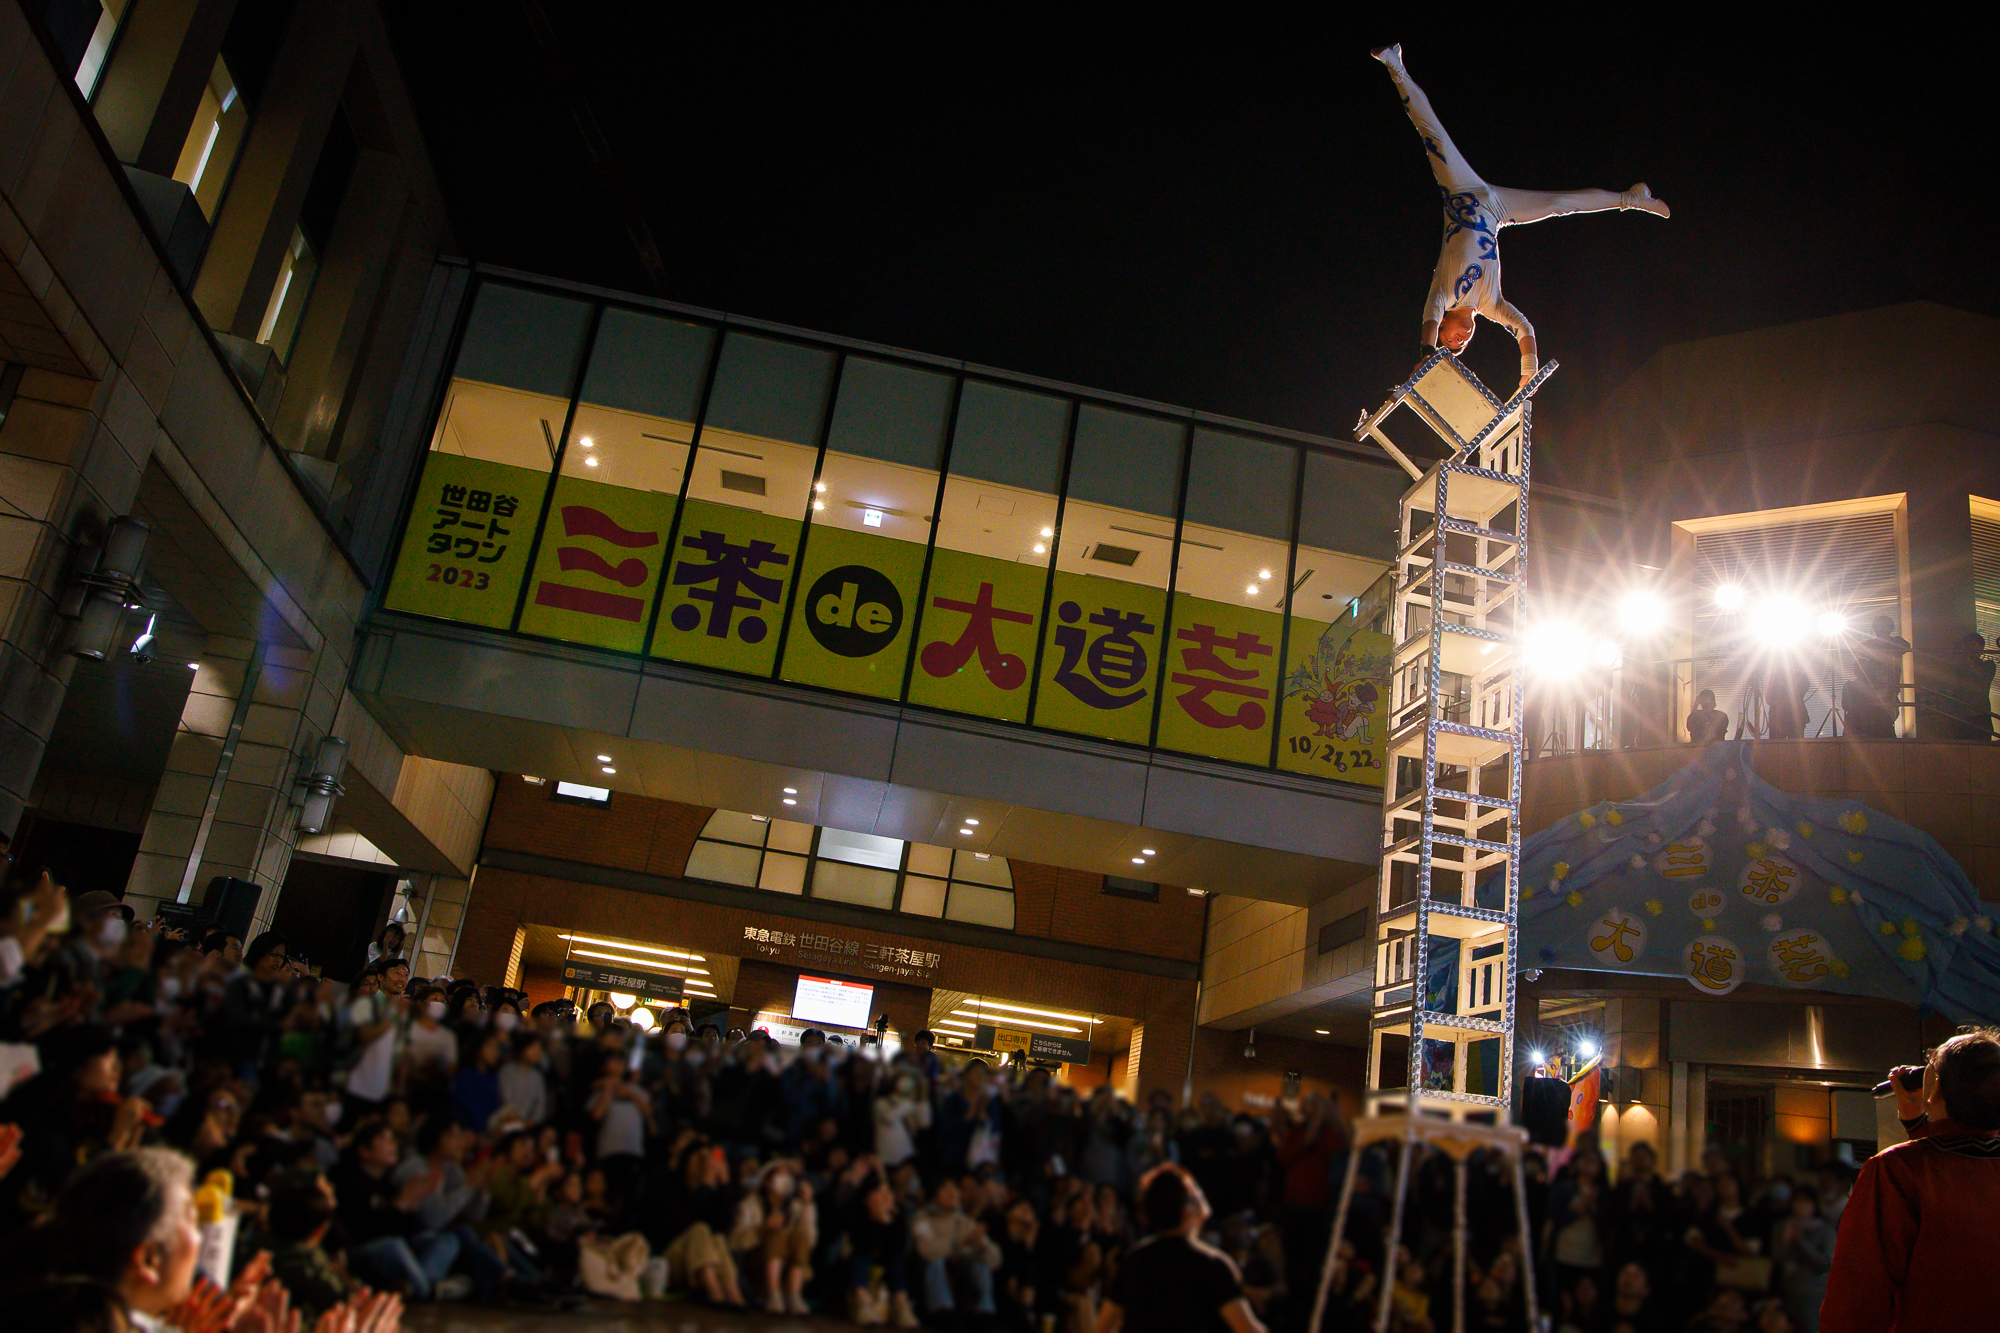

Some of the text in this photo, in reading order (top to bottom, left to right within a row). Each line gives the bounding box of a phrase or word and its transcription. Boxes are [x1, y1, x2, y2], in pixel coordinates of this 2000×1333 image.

[440, 484, 519, 518] 世田谷
[432, 509, 510, 539] アート
[427, 532, 507, 563] タウン
[426, 563, 490, 590] 2023
[743, 927, 941, 969] 東急電鉄 世田谷線 三軒茶屋駅
[756, 943, 781, 956] Tokyu
[797, 950, 837, 965] Setagaya
[839, 956, 856, 967] Line
[598, 973, 647, 990] 三軒茶屋駅
